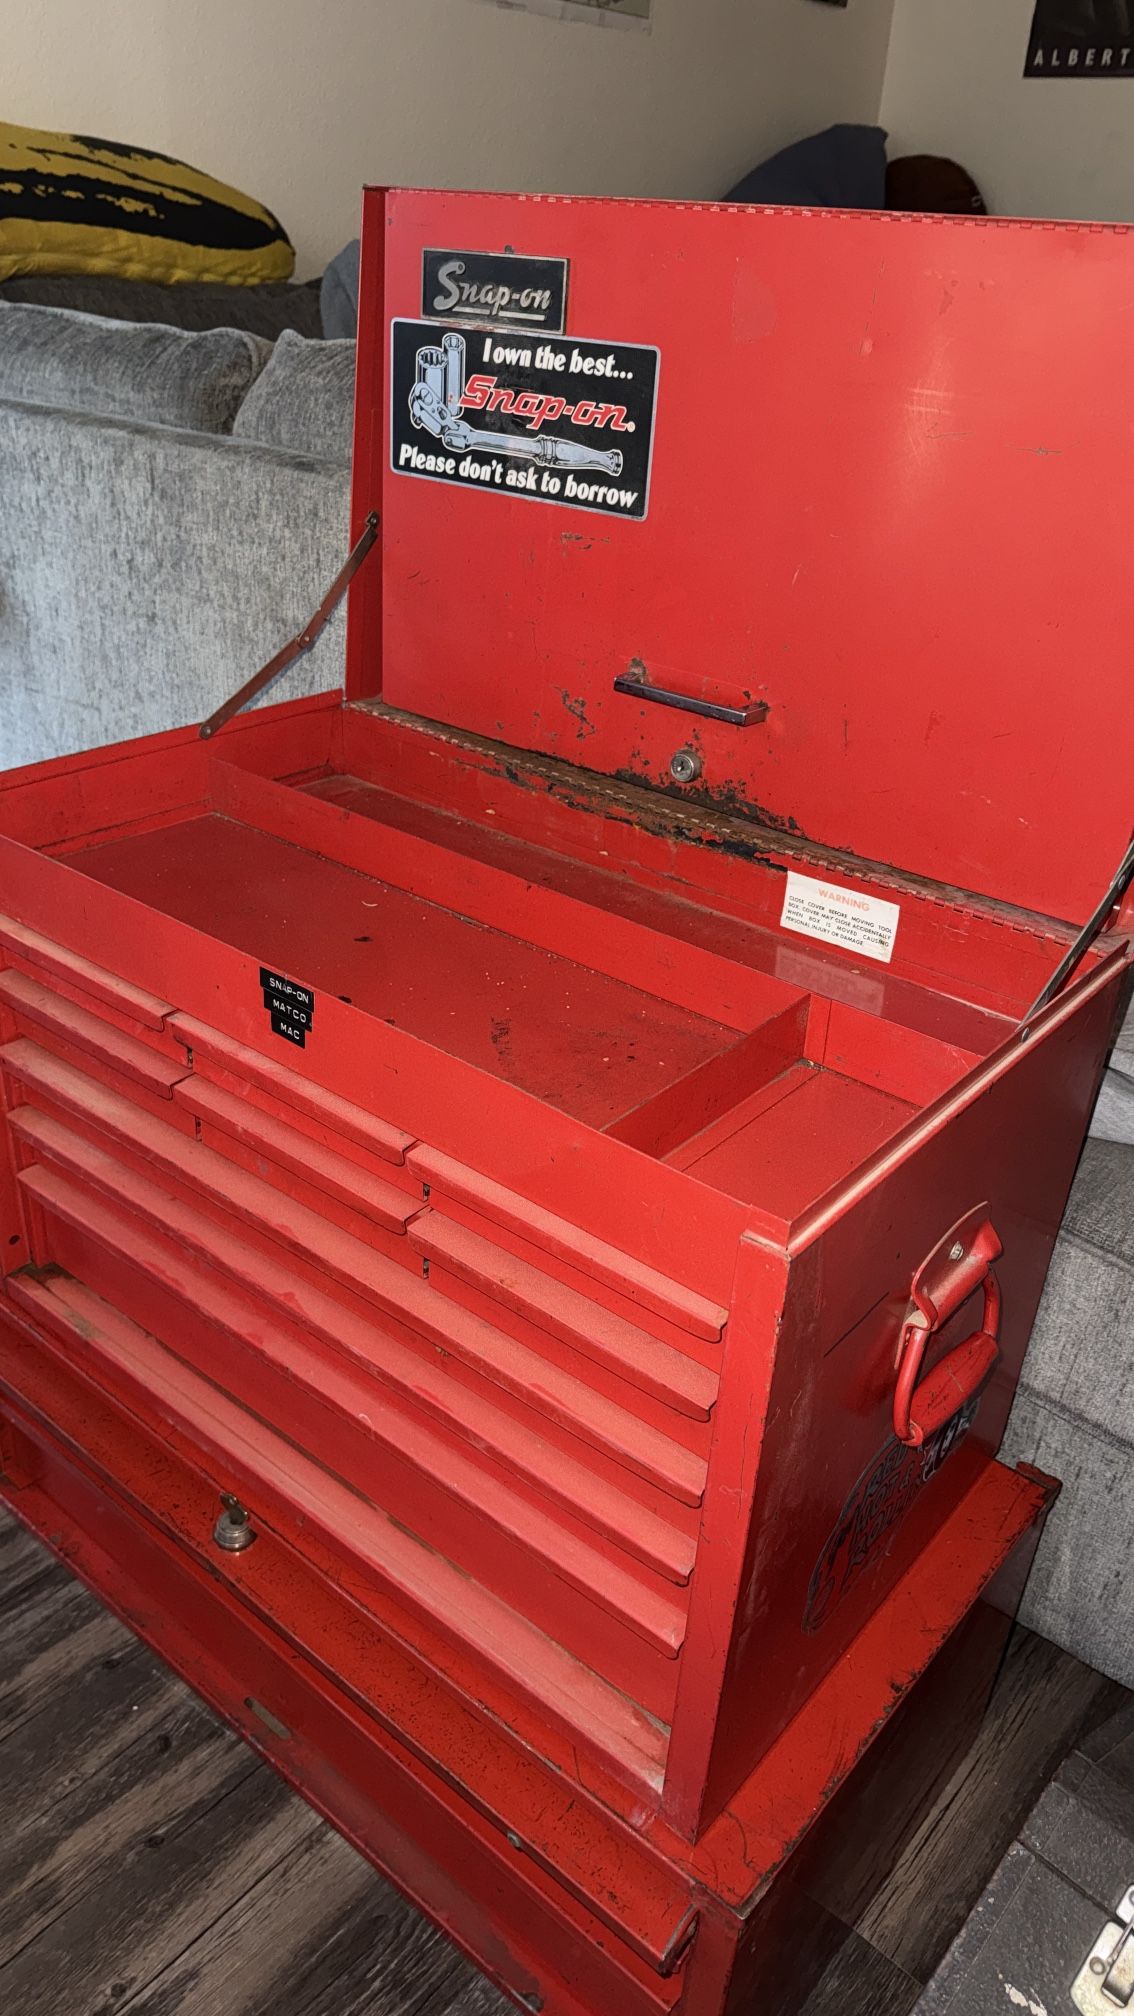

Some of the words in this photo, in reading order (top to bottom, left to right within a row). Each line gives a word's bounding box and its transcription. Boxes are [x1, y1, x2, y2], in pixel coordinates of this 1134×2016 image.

[1033, 48, 1131, 67] ALBERT
[433, 261, 551, 316] Snap-on
[482, 337, 493, 363] I
[493, 347, 532, 369] own
[535, 345, 565, 372] the
[569, 348, 634, 380] best...
[398, 443, 455, 475] Please
[459, 455, 504, 482] don't
[505, 469, 537, 492] ask
[540, 473, 561, 494] to
[564, 474, 638, 509] borrow
[789, 895, 805, 905] CLOSE
[807, 901, 825, 911] COVER
[828, 908, 848, 919] BEFORE
[851, 916, 875, 928] MOVING
[878, 924, 892, 934] TOOL
[818, 887, 871, 912] WARNING
[785, 915, 810, 928] PERSONAL
[811, 924, 830, 935] INJURY
[831, 930, 839, 938] OR
[840, 933, 864, 946] DAMAGE
[787, 909, 803, 918] WHEN
[808, 916, 820, 924] BOX
[836, 925, 858, 937] MOVED
[862, 934, 889, 948] CAUSING
[802, 906, 819, 916] COVER
[821, 912, 834, 921] MAY
[835, 917, 851, 928] CLOSE
[852, 923, 892, 940] ACCIDENTALLY
[269, 977, 309, 1004] SNAP-ON
[272, 999, 307, 1023] MATCO
[280, 1022, 300, 1040] MAC
